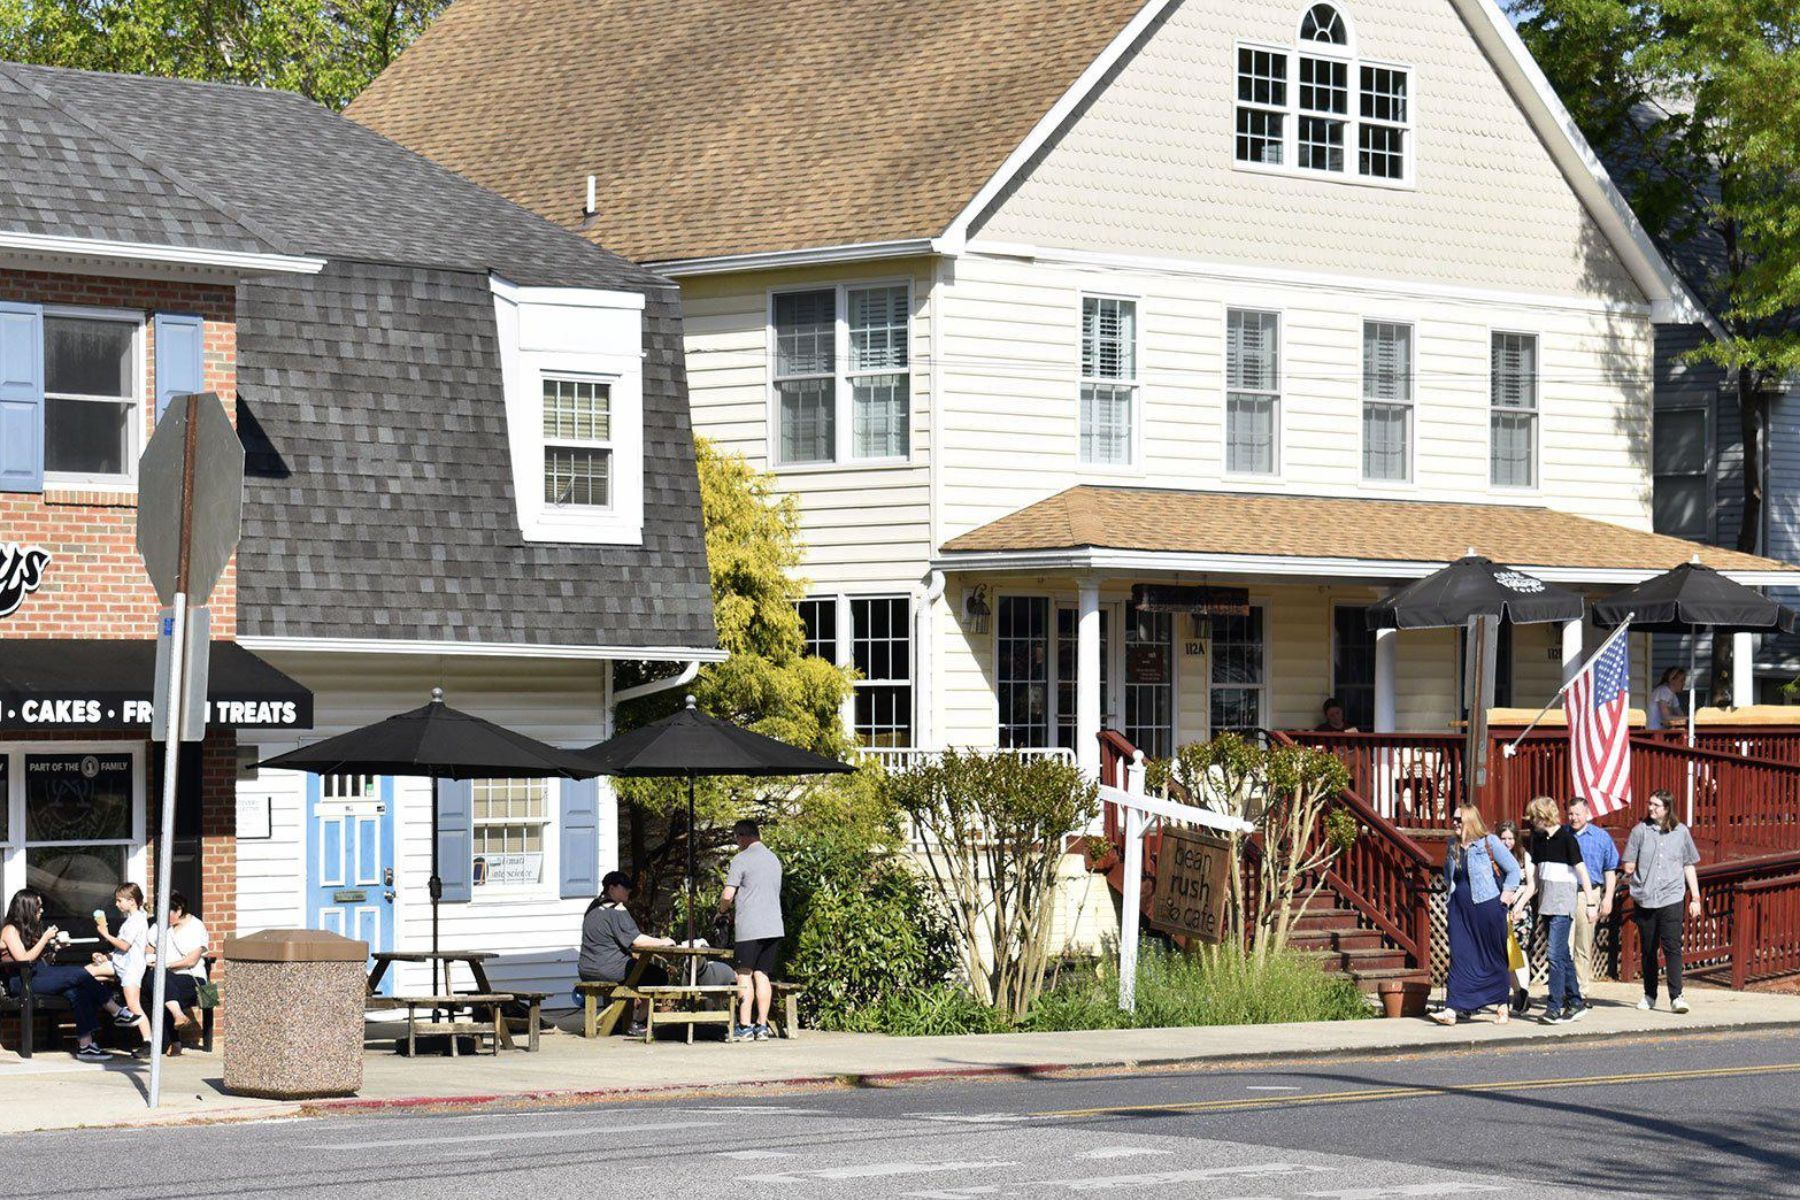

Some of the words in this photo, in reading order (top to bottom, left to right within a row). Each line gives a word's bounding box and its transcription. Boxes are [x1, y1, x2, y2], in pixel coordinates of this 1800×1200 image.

[1185, 642, 1205, 655] 112A
[22, 700, 101, 723] CAKES
[217, 701, 296, 723] TREATS
[30, 762, 50, 771] PART
[52, 762, 63, 771] OF
[65, 762, 79, 771] THE
[101, 761, 128, 771] FAMILY
[1171, 874, 1210, 901] rush
